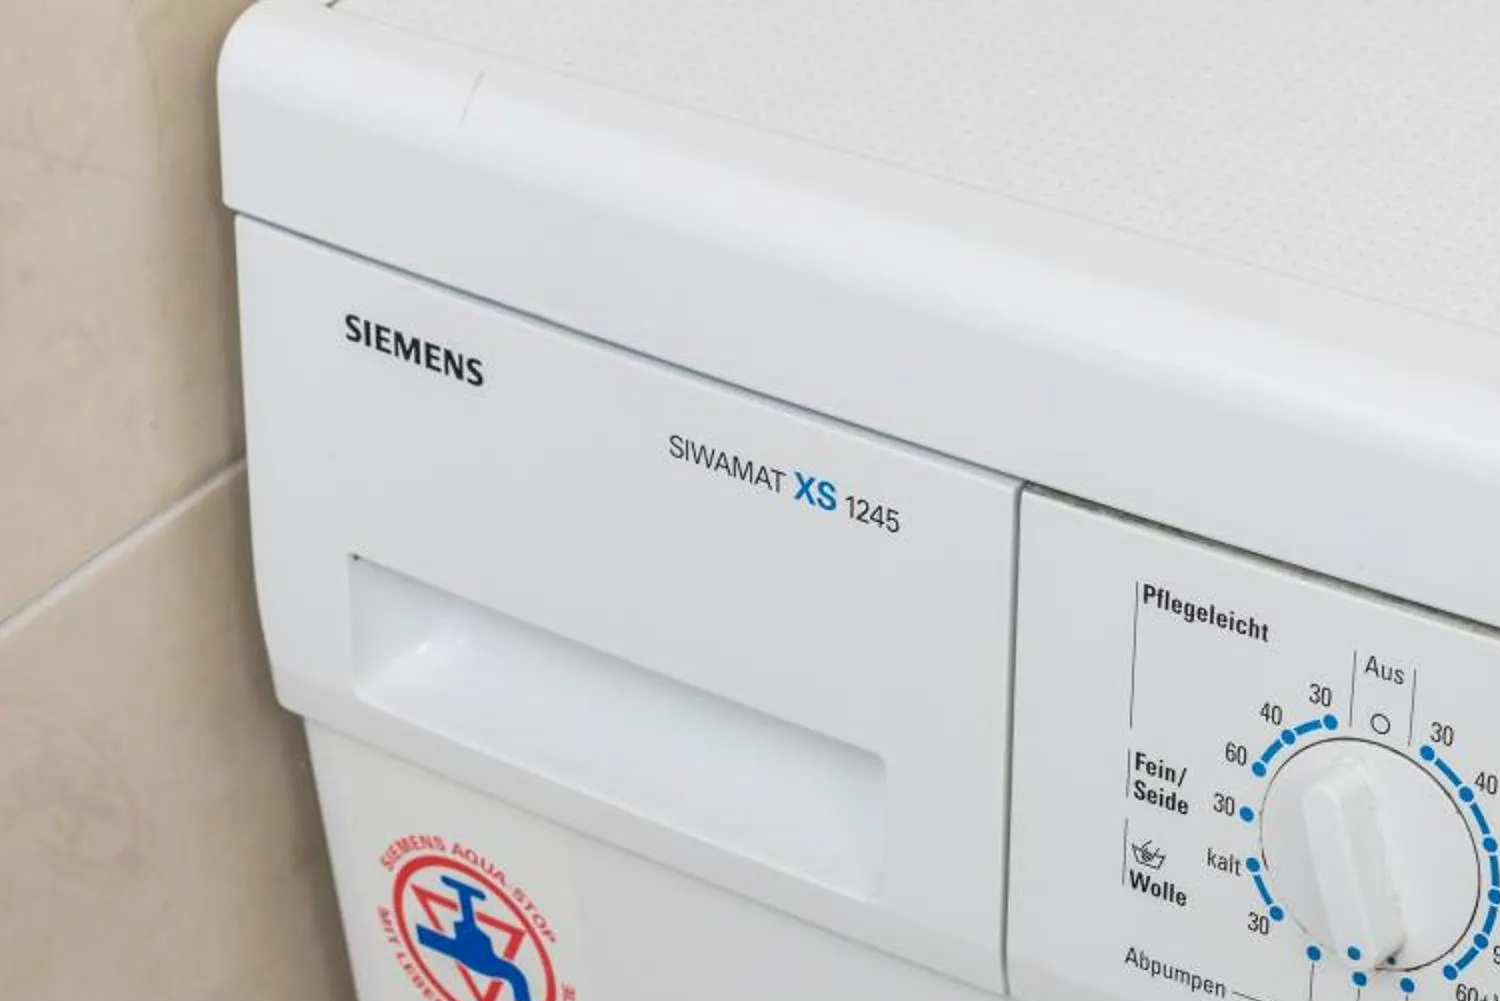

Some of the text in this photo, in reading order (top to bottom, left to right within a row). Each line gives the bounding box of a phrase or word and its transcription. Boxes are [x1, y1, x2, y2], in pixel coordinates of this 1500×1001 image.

[345, 314, 484, 387] SIEMENS
[669, 435, 900, 533] SIWAMAT XS 1245
[1143, 583, 1269, 642] Pflegeleicht
[1365, 656, 1405, 685] Aus
[1309, 684, 1332, 707] 30
[1260, 703, 1283, 725] 40
[1431, 723, 1454, 745] 30
[1135, 752, 1187, 785] Fein/
[1225, 743, 1247, 765] 60
[1133, 780, 1189, 815] Seide
[1474, 772, 1498, 795] 40
[1213, 794, 1235, 816] 30
[452, 843, 506, 886] AQUA
[1207, 848, 1240, 877] kalt
[1130, 870, 1187, 906] Wolle
[1247, 913, 1270, 935] 30
[1124, 947, 1227, 999] Abpumpen
